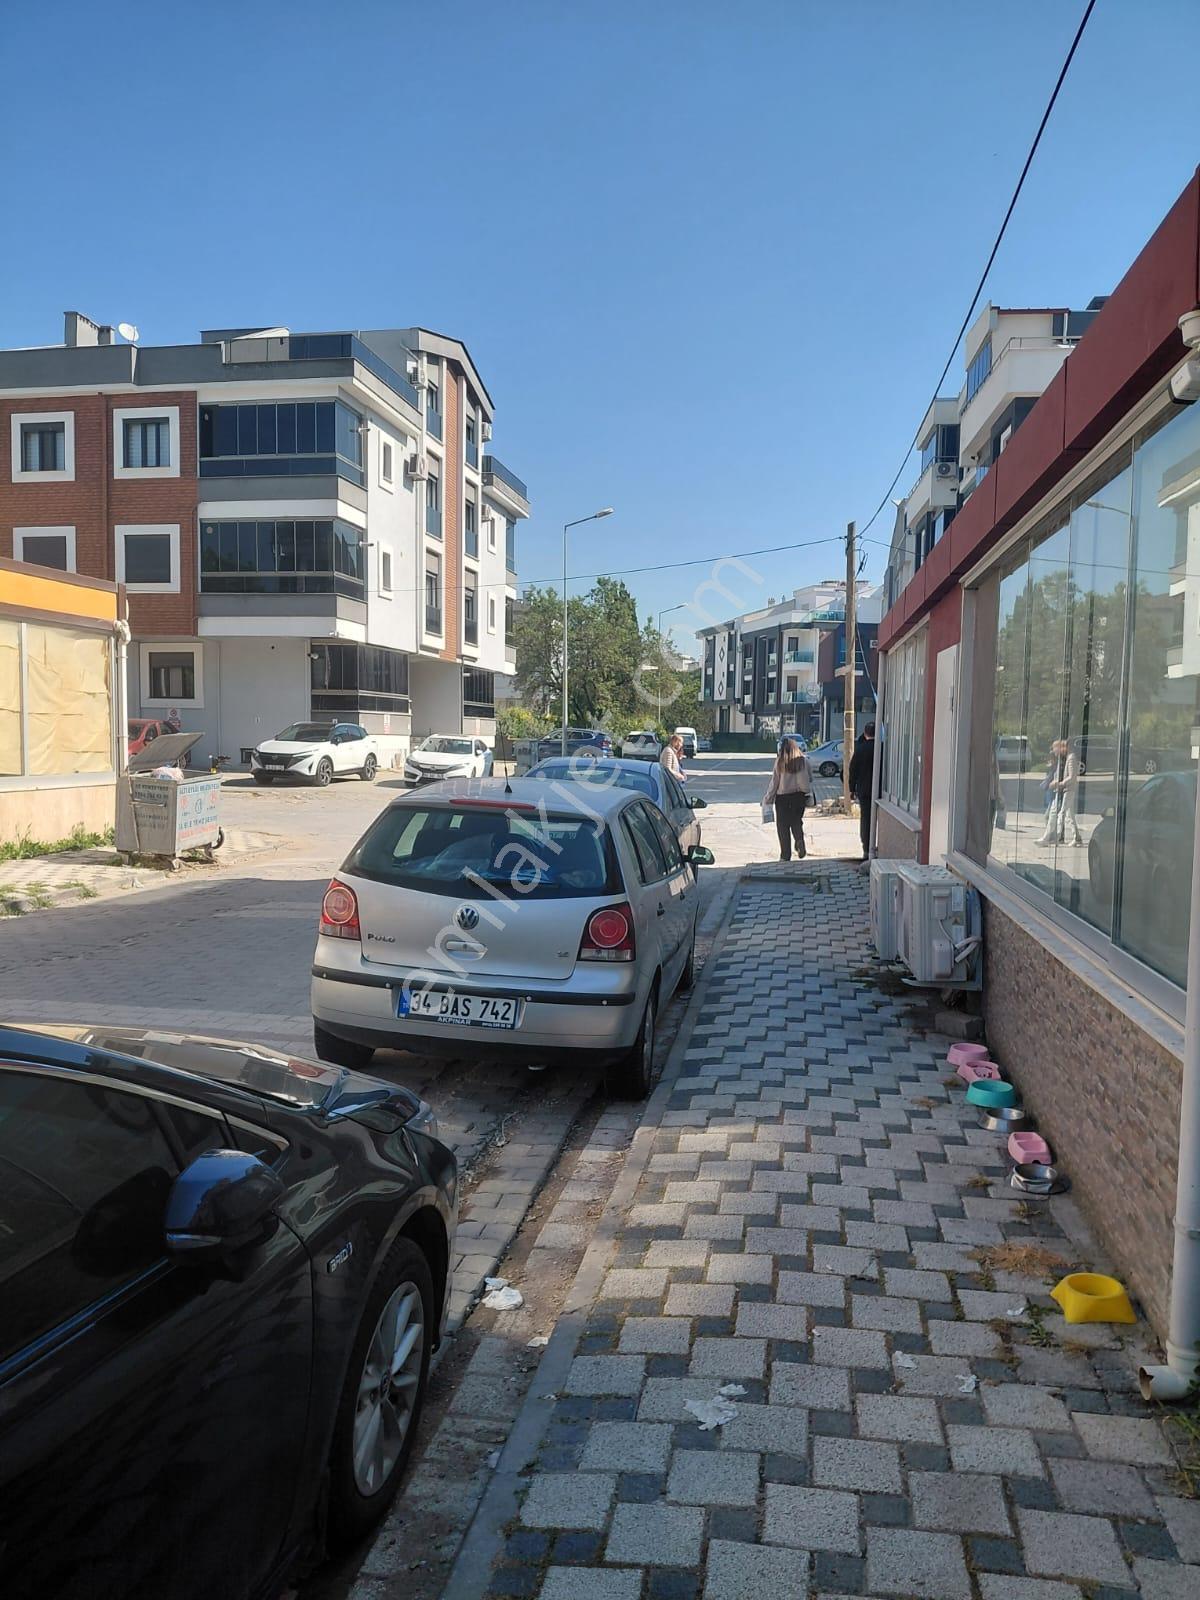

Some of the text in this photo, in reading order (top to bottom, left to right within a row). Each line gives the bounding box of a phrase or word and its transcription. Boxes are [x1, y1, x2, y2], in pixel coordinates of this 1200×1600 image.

[411, 992, 512, 1021] 34 BAS 742
[437, 1016, 472, 1025] AKPINAR
